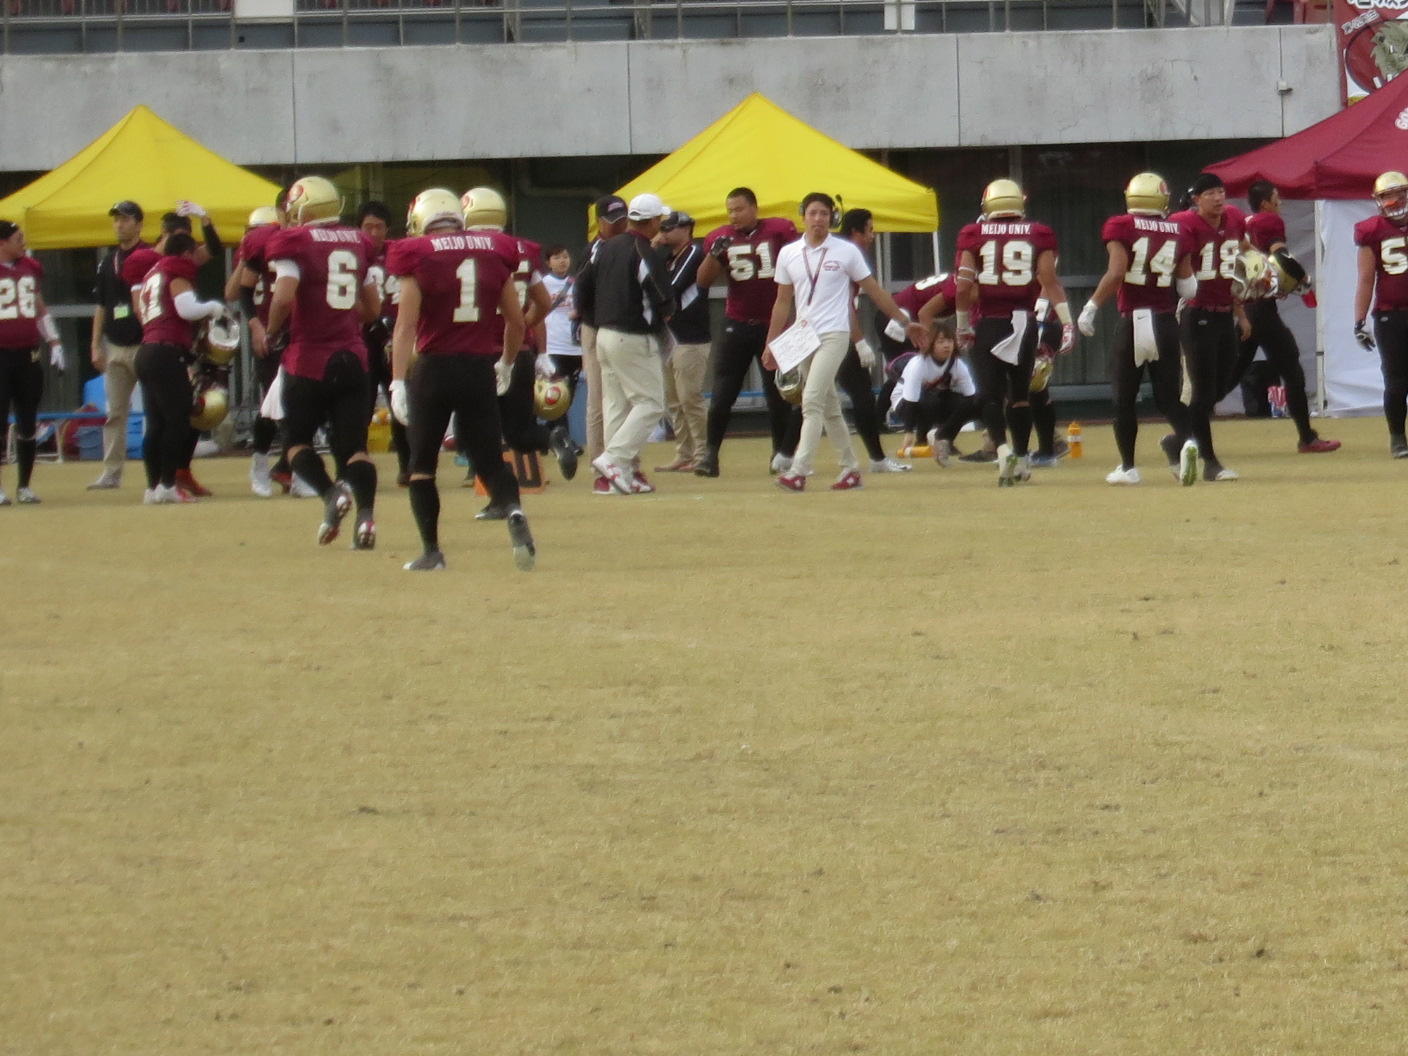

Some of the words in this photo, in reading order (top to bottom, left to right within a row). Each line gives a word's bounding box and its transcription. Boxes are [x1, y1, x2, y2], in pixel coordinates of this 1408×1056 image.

[430, 236, 464, 252] MEIJO
[465, 235, 495, 251] UNIV.
[981, 223, 1006, 235] MEIJO
[326, 250, 358, 310] 6
[727, 242, 775, 282] 51
[978, 240, 1034, 286] 19
[1124, 236, 1177, 288] 14
[1196, 239, 1240, 281] 18
[0, 276, 36, 319] 26
[453, 257, 480, 323] 1
